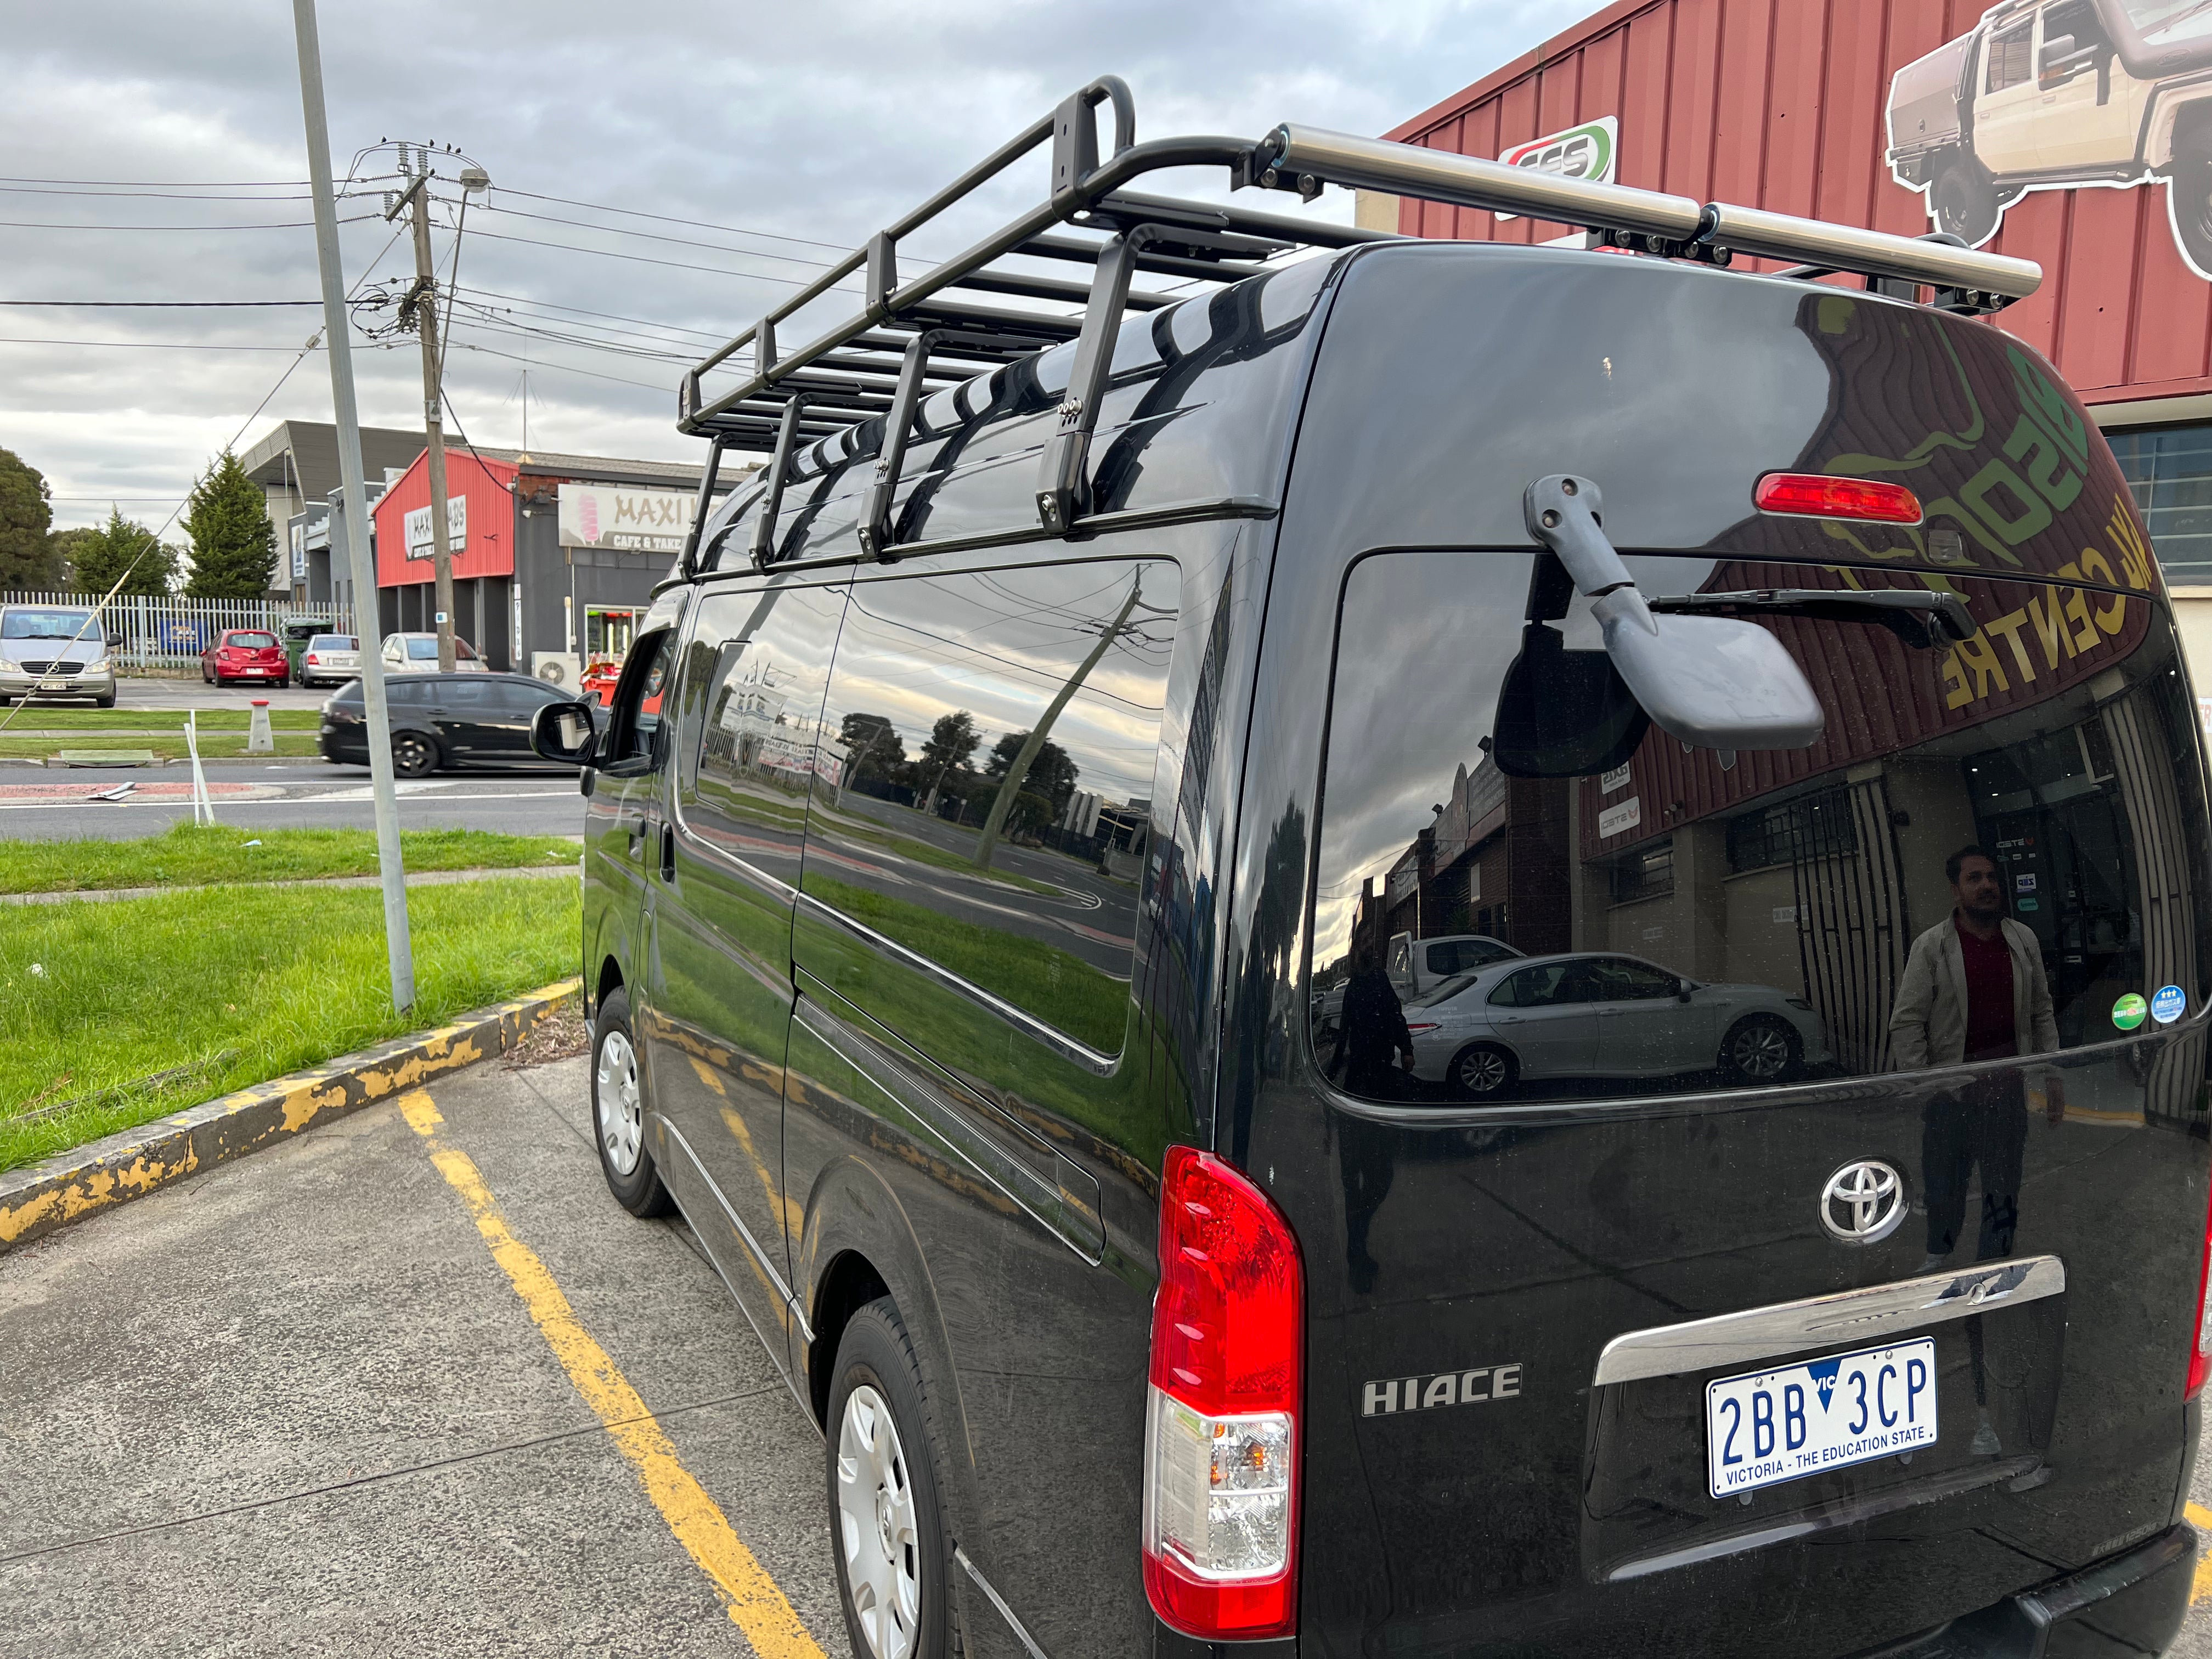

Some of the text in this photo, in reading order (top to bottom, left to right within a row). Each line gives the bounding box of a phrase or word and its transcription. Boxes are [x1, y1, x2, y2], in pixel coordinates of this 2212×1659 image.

[614, 494, 682, 527] MAXI
[614, 534, 641, 548] CAFE
[643, 536, 651, 548] &
[1363, 1365, 1521, 1415] HIACE
[1813, 1375, 1836, 1392] VIC
[1719, 1358, 1926, 1466] 2BB 3CP
[1726, 1460, 1784, 1485] VICTORIA
[1796, 1451, 1819, 1468] THE
[1822, 1436, 1888, 1461] EDUCATION
[1892, 1426, 1925, 1444] STATE
